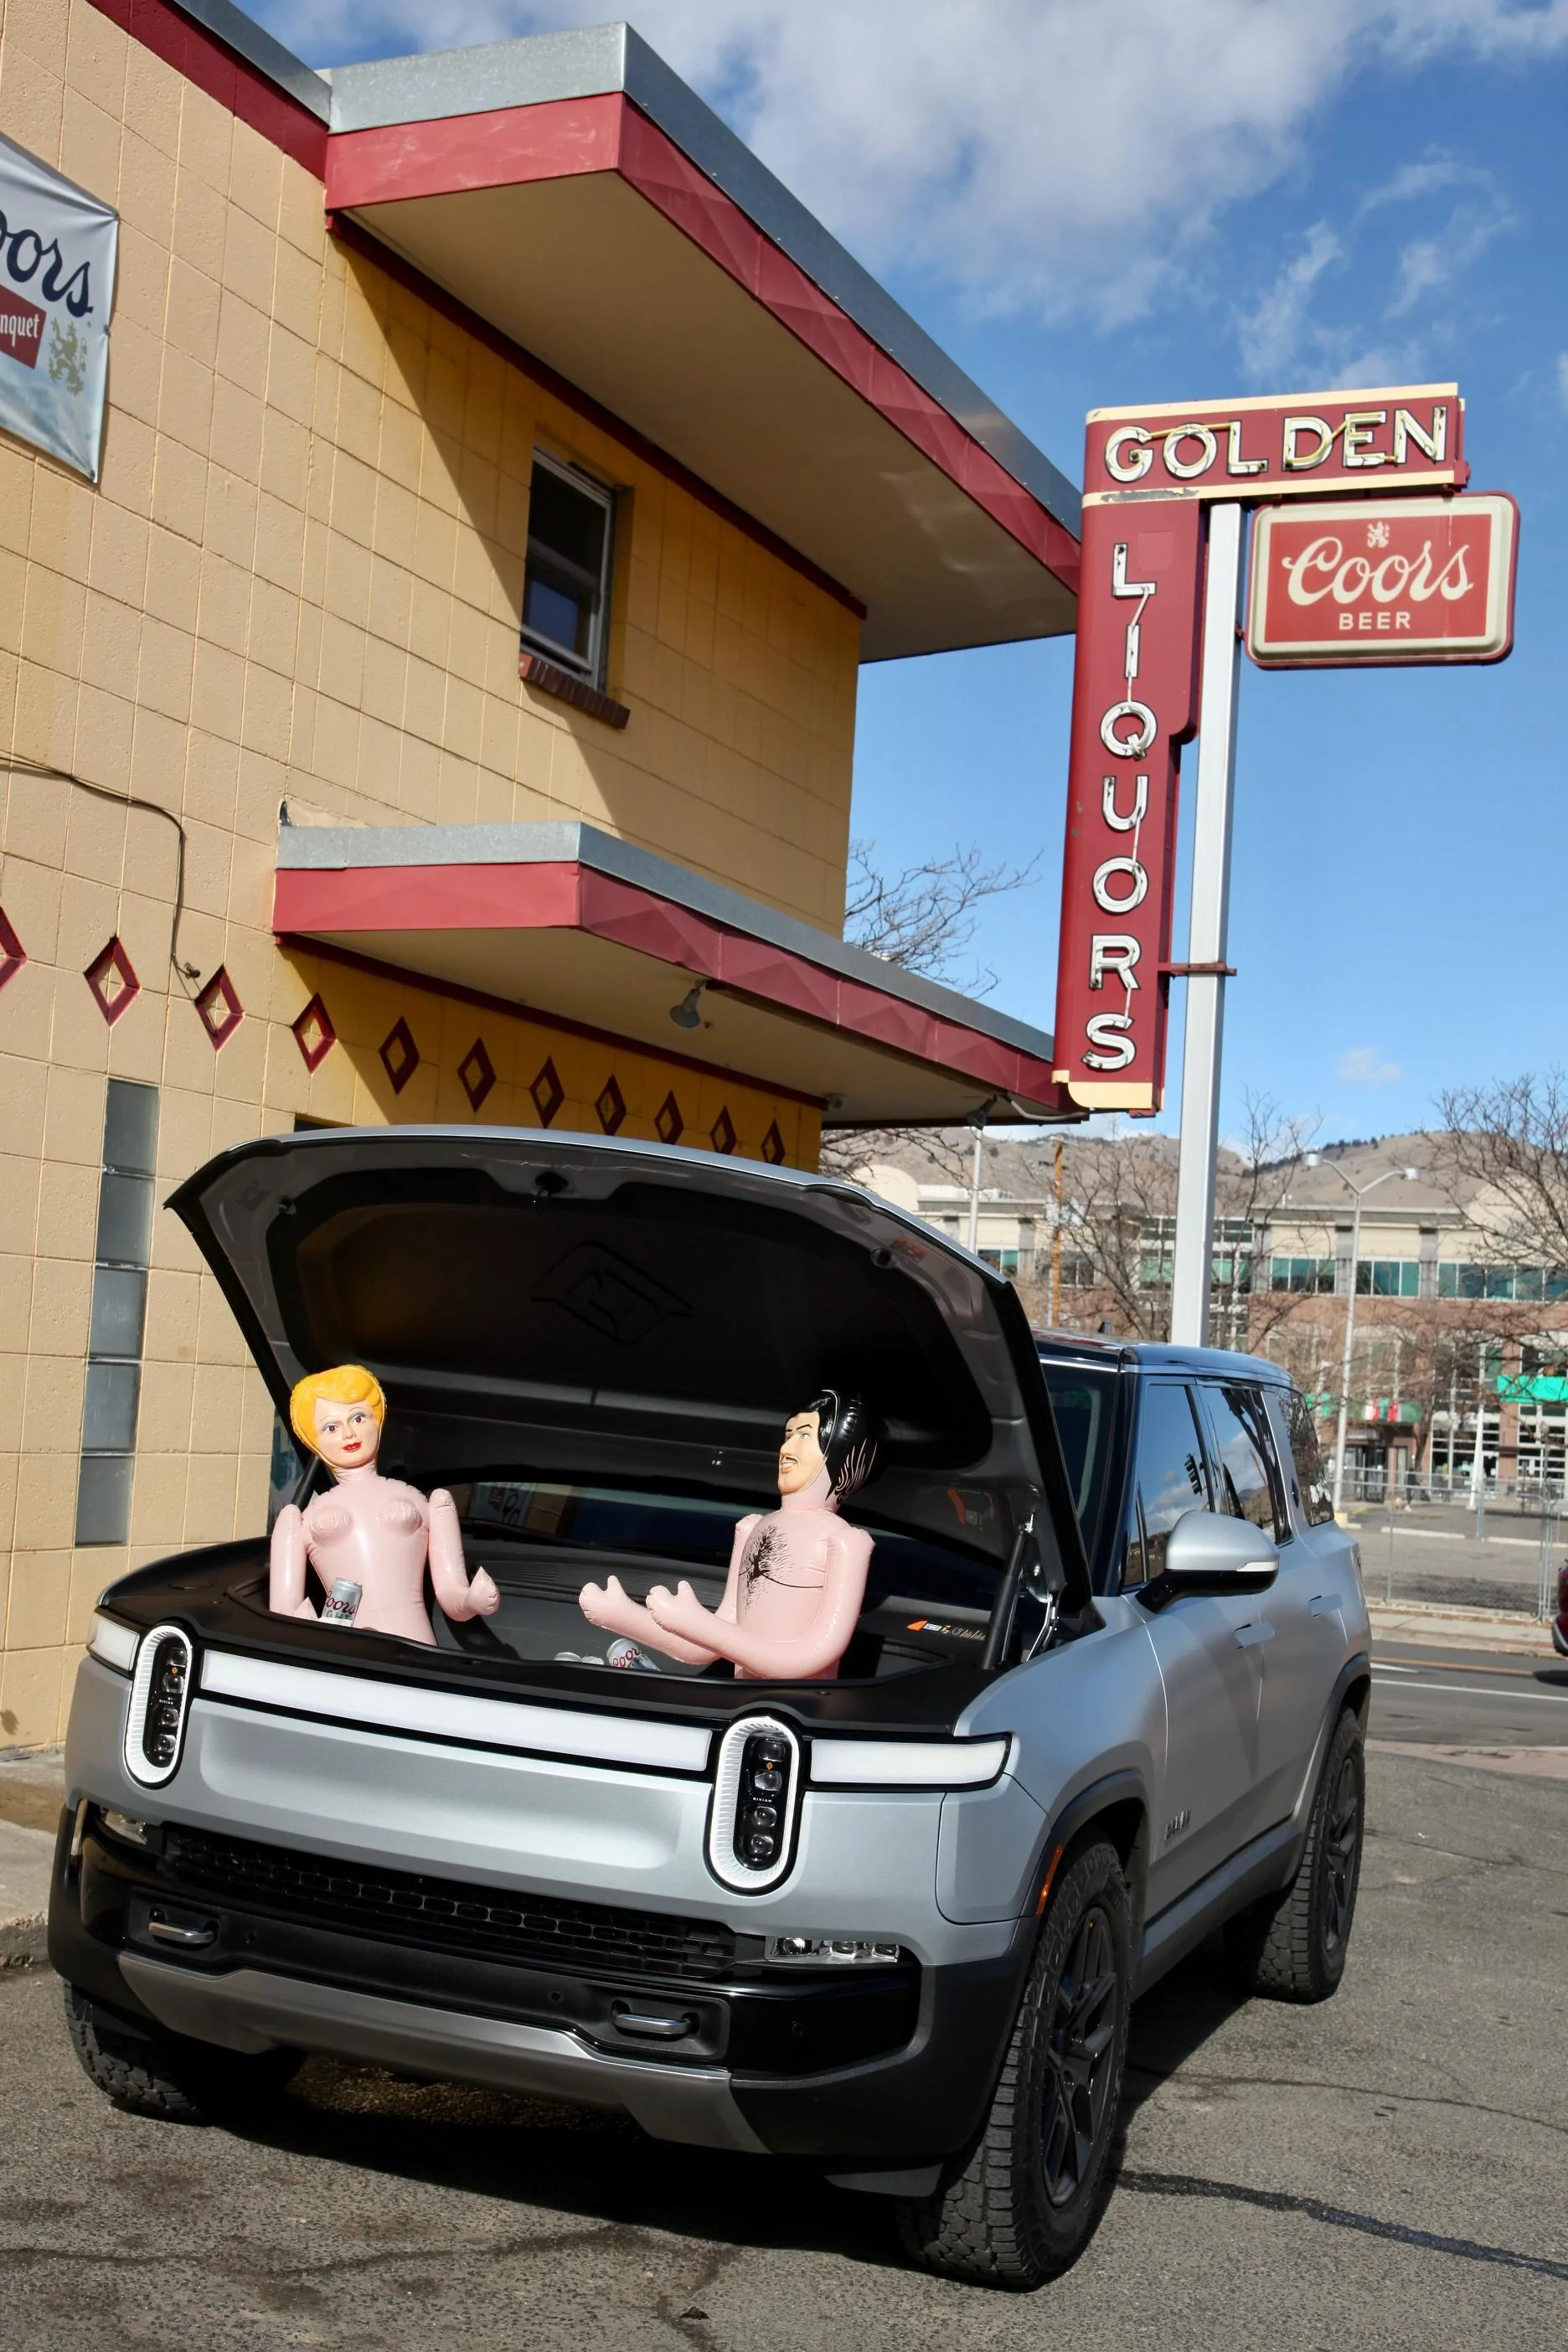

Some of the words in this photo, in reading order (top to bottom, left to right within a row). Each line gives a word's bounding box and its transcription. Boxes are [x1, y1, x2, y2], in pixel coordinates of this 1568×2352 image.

[0, 211, 94, 318] ors
[1104, 405, 1448, 483] GOLDEN
[1282, 539, 1474, 606] Coors
[1338, 611, 1411, 631] BEER
[1082, 543, 1158, 1070] LIQUORS
